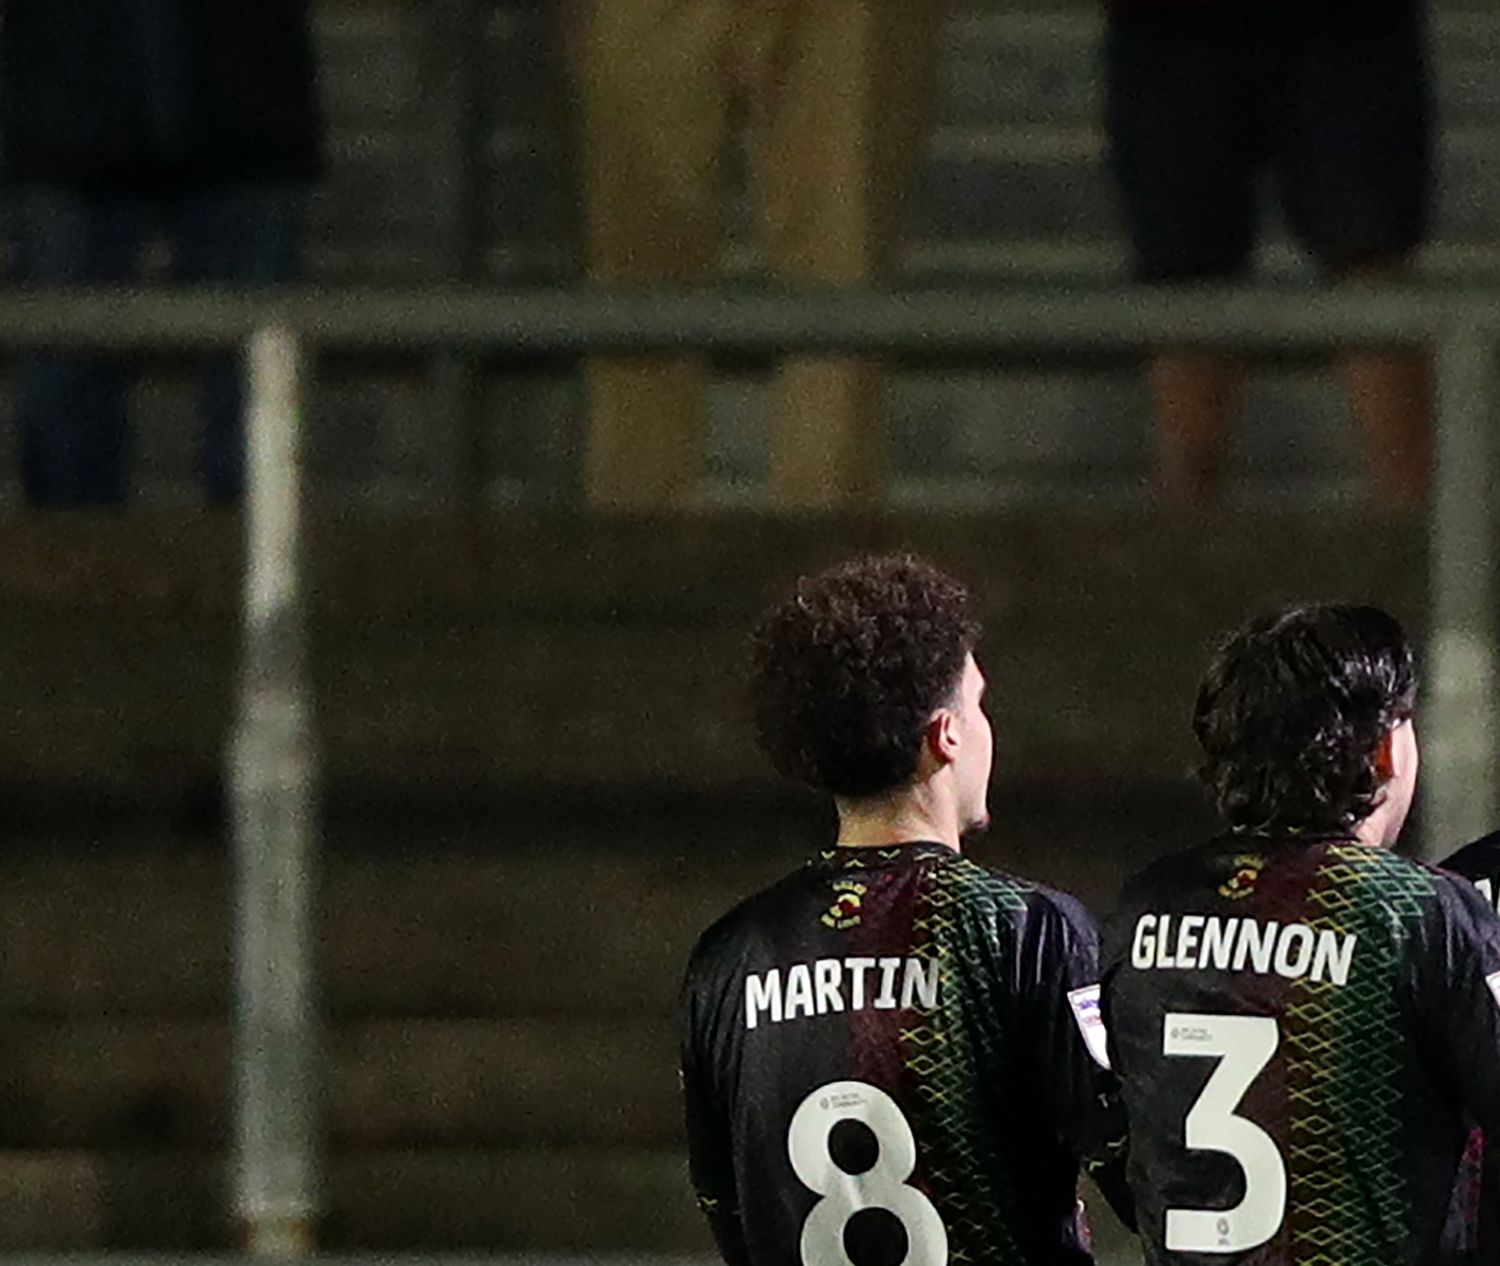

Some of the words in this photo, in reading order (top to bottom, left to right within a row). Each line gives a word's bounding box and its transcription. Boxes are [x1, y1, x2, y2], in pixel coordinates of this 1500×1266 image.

[1131, 914, 1356, 986] GLENNON
[745, 957, 939, 1029] MARTIN
[1164, 1013, 1286, 1254] 3
